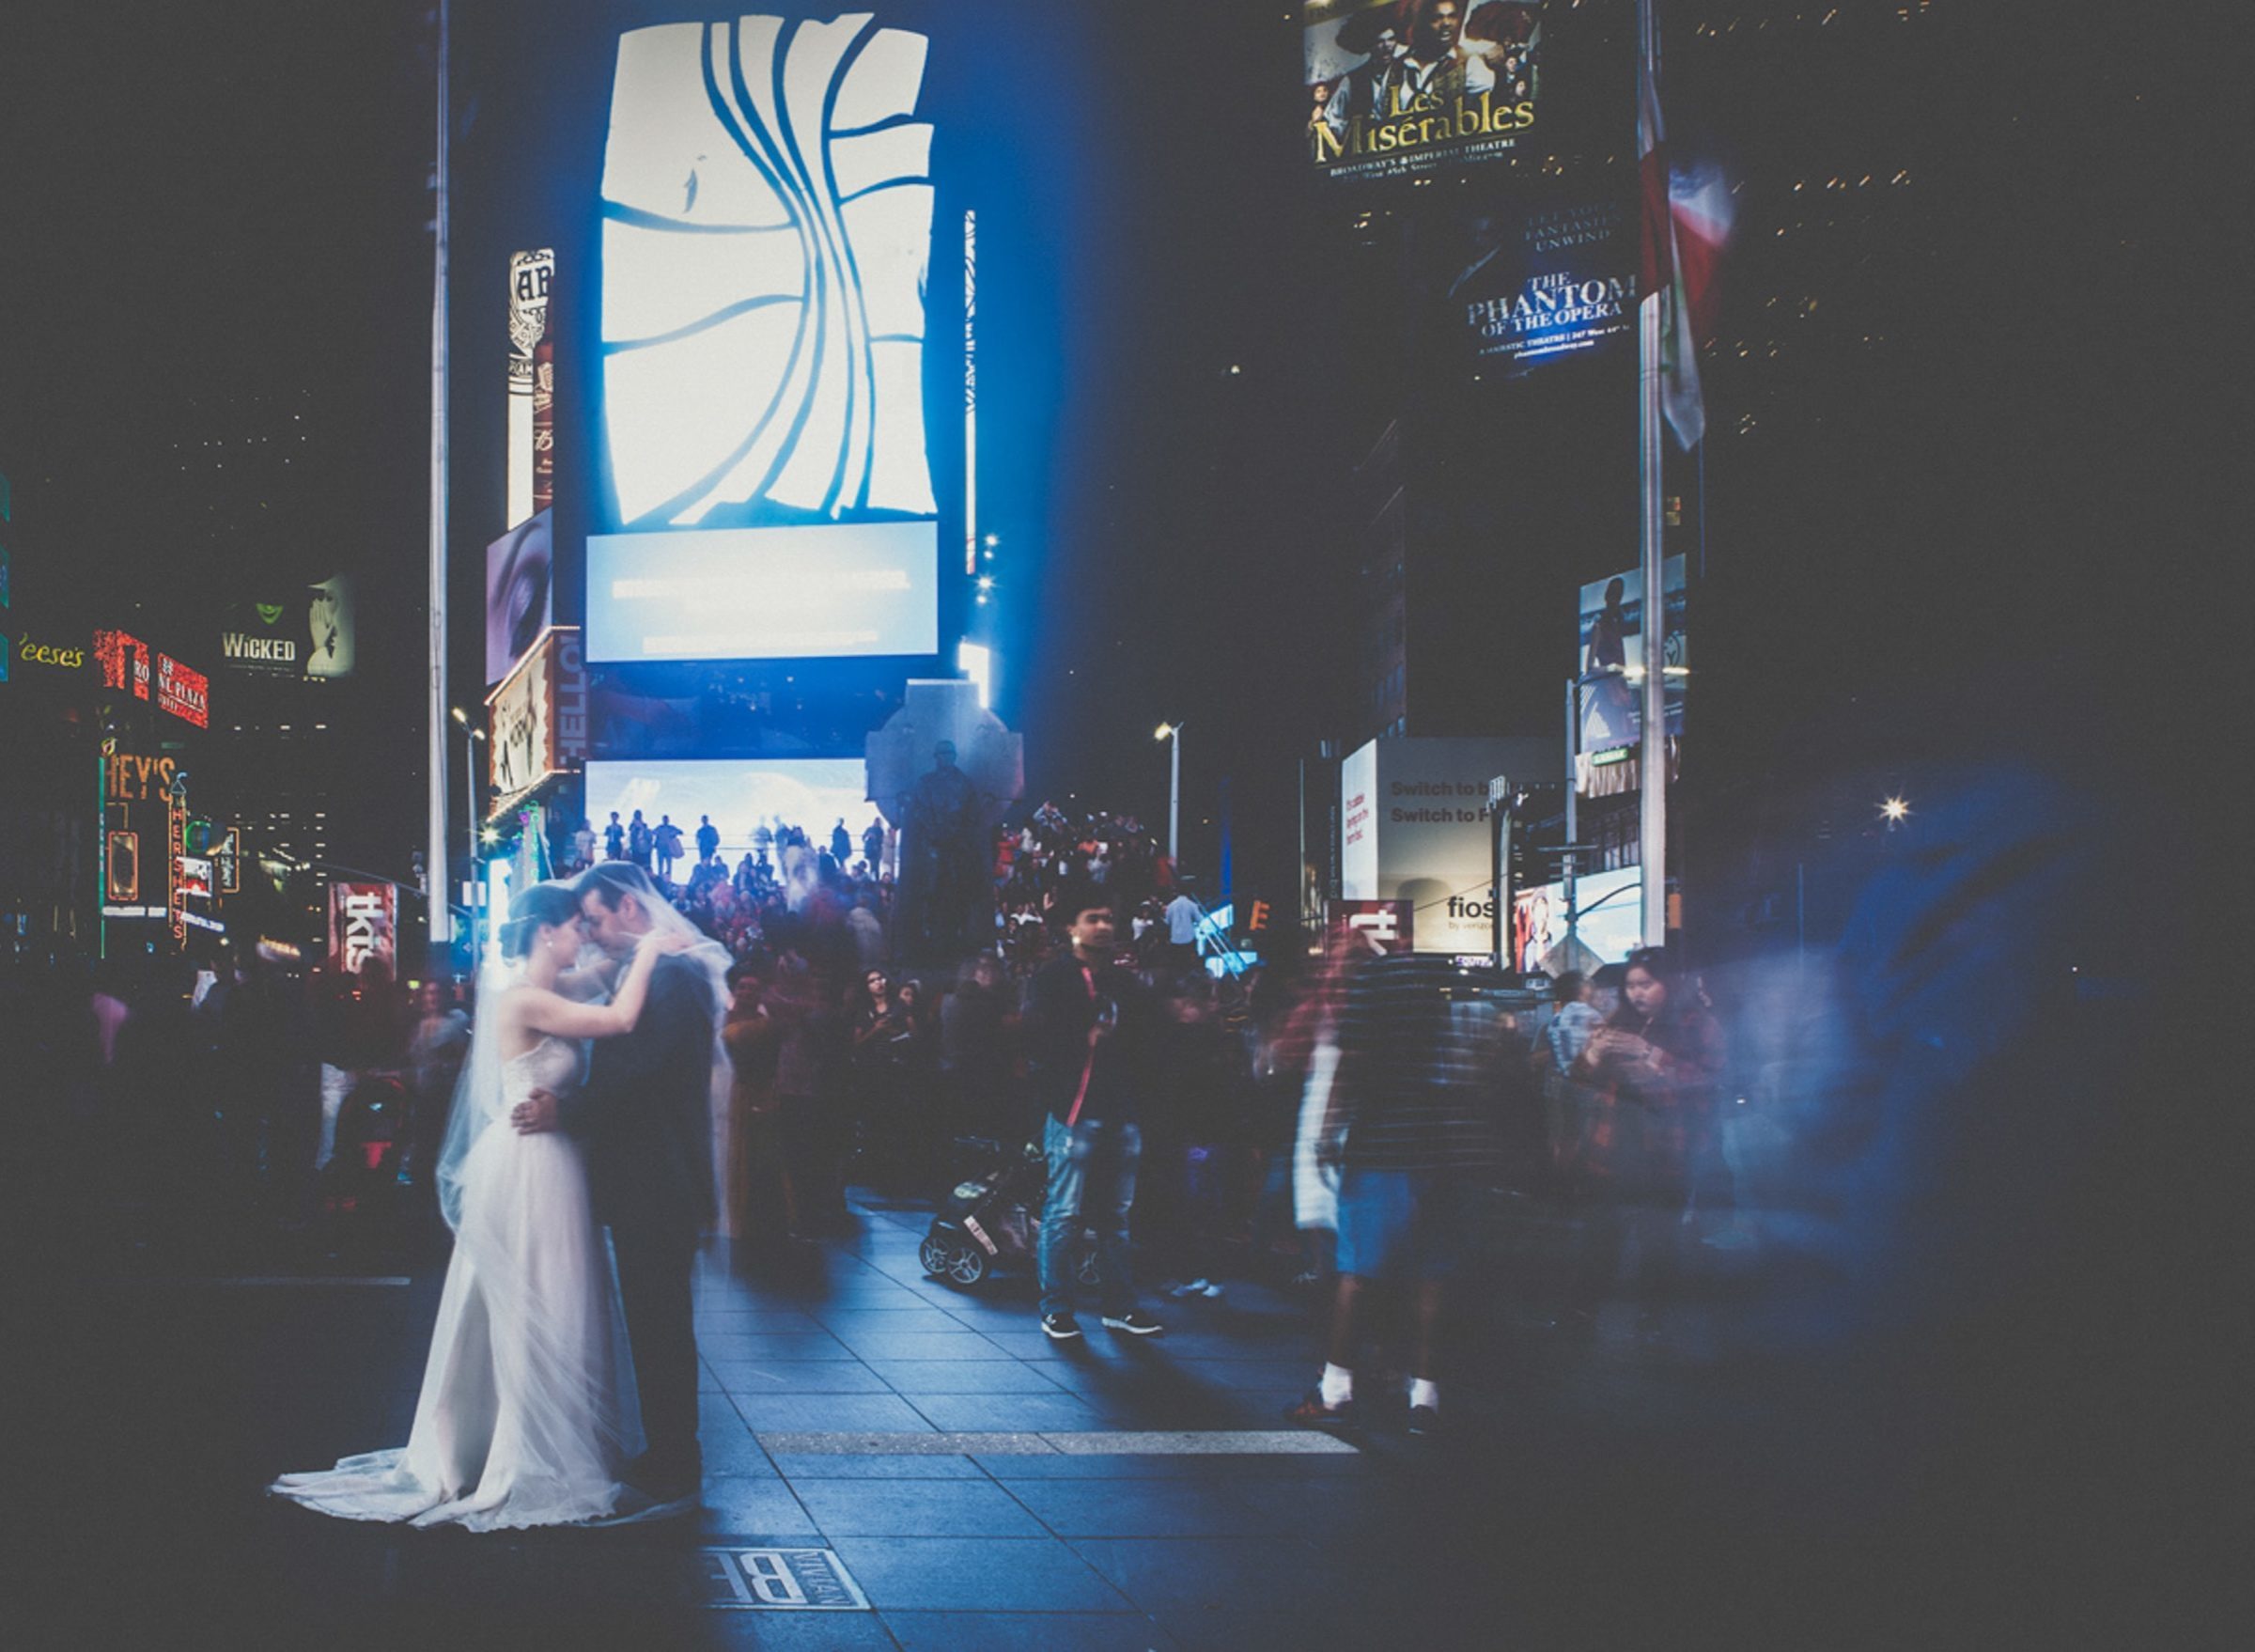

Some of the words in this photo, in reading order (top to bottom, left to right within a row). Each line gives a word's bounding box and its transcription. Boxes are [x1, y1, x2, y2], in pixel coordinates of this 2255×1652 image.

[1390, 85, 1445, 117] Les
[1312, 91, 1535, 164] Misérables
[1464, 137, 1516, 154] THEATRE
[1535, 229, 1610, 253] UNWIND
[1527, 272, 1571, 292] THE
[1466, 274, 1637, 325] PHANTOM
[1481, 320, 1508, 337] OF
[1510, 314, 1553, 333] THE
[1553, 301, 1623, 325] OPERA
[19, 631, 86, 668] eese's
[1392, 781, 1452, 796] Switch
[1456, 782, 1474, 796] to
[1392, 807, 1453, 822] Switch
[1456, 808, 1475, 822] to
[1447, 895, 1493, 919] fios
[345, 891, 383, 974] tkts
[1349, 909, 1397, 957] tk
